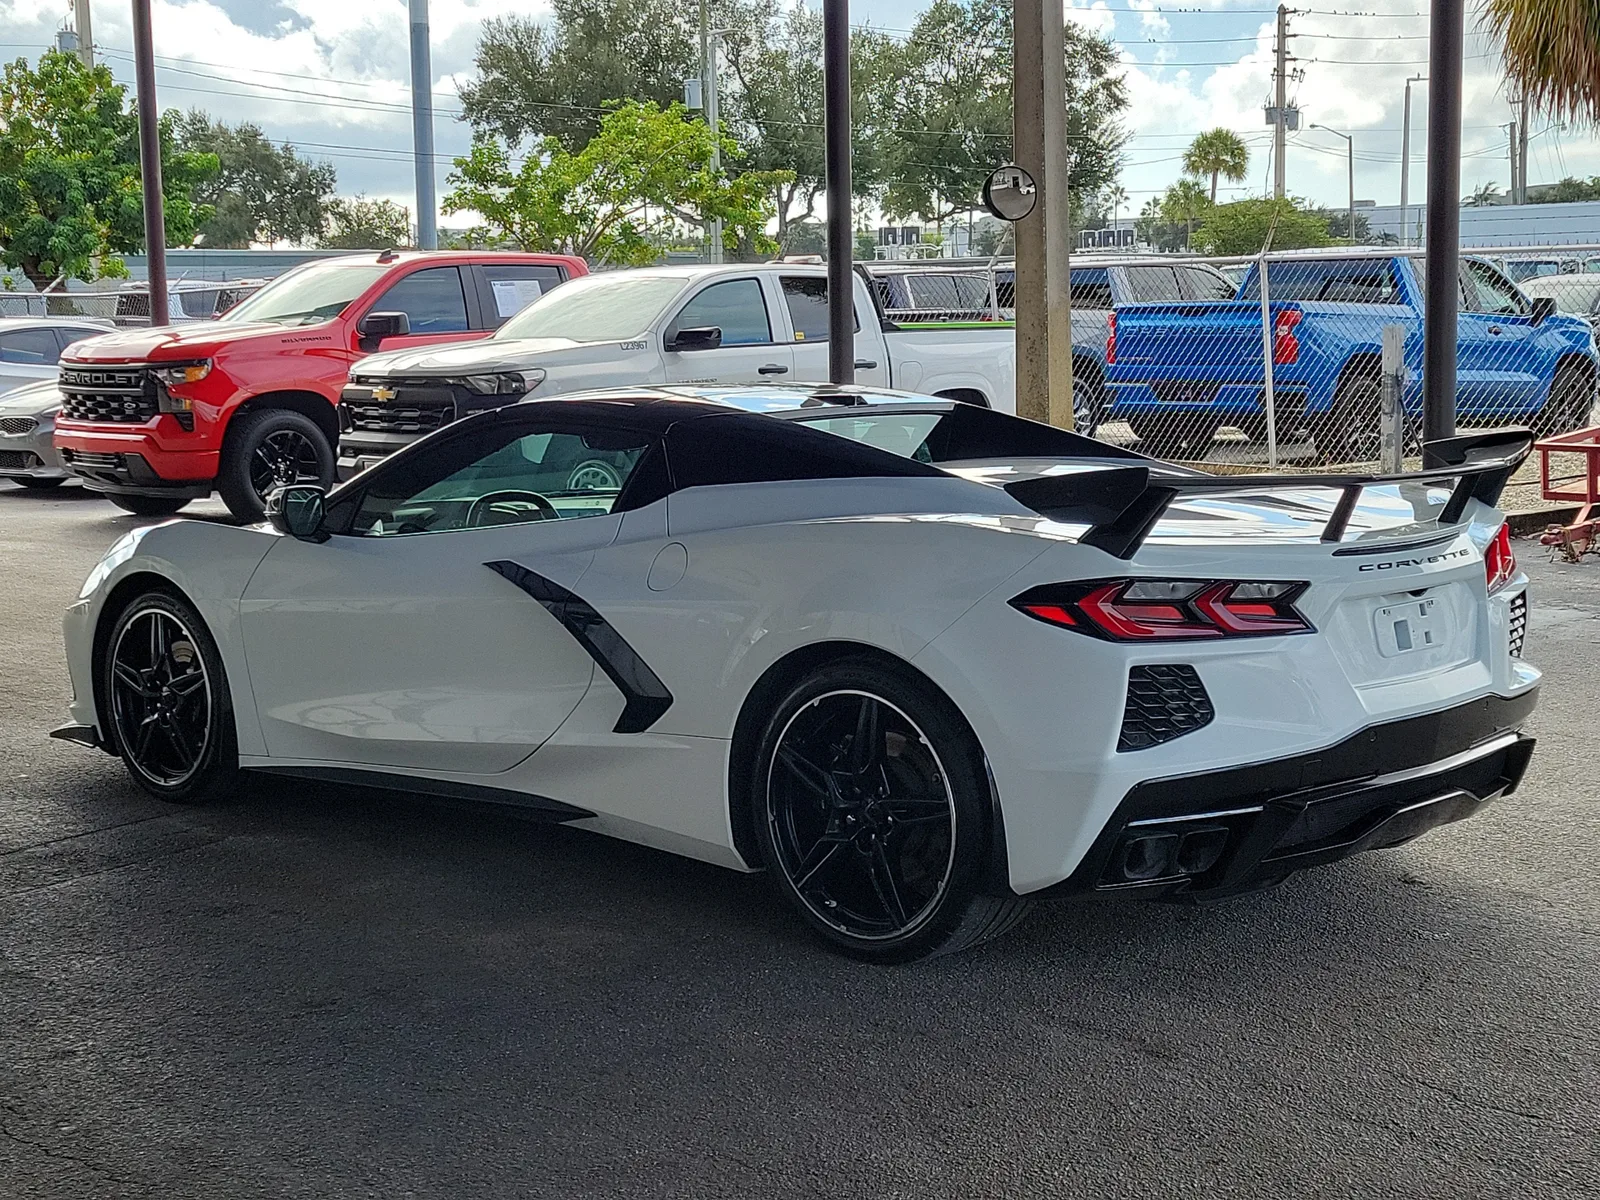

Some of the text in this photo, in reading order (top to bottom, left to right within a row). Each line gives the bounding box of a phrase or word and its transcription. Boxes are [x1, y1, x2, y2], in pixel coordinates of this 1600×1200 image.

[620, 340, 648, 351] L23967
[60, 371, 140, 385] CHEVROLET
[1358, 548, 1470, 572] CORVETTE
